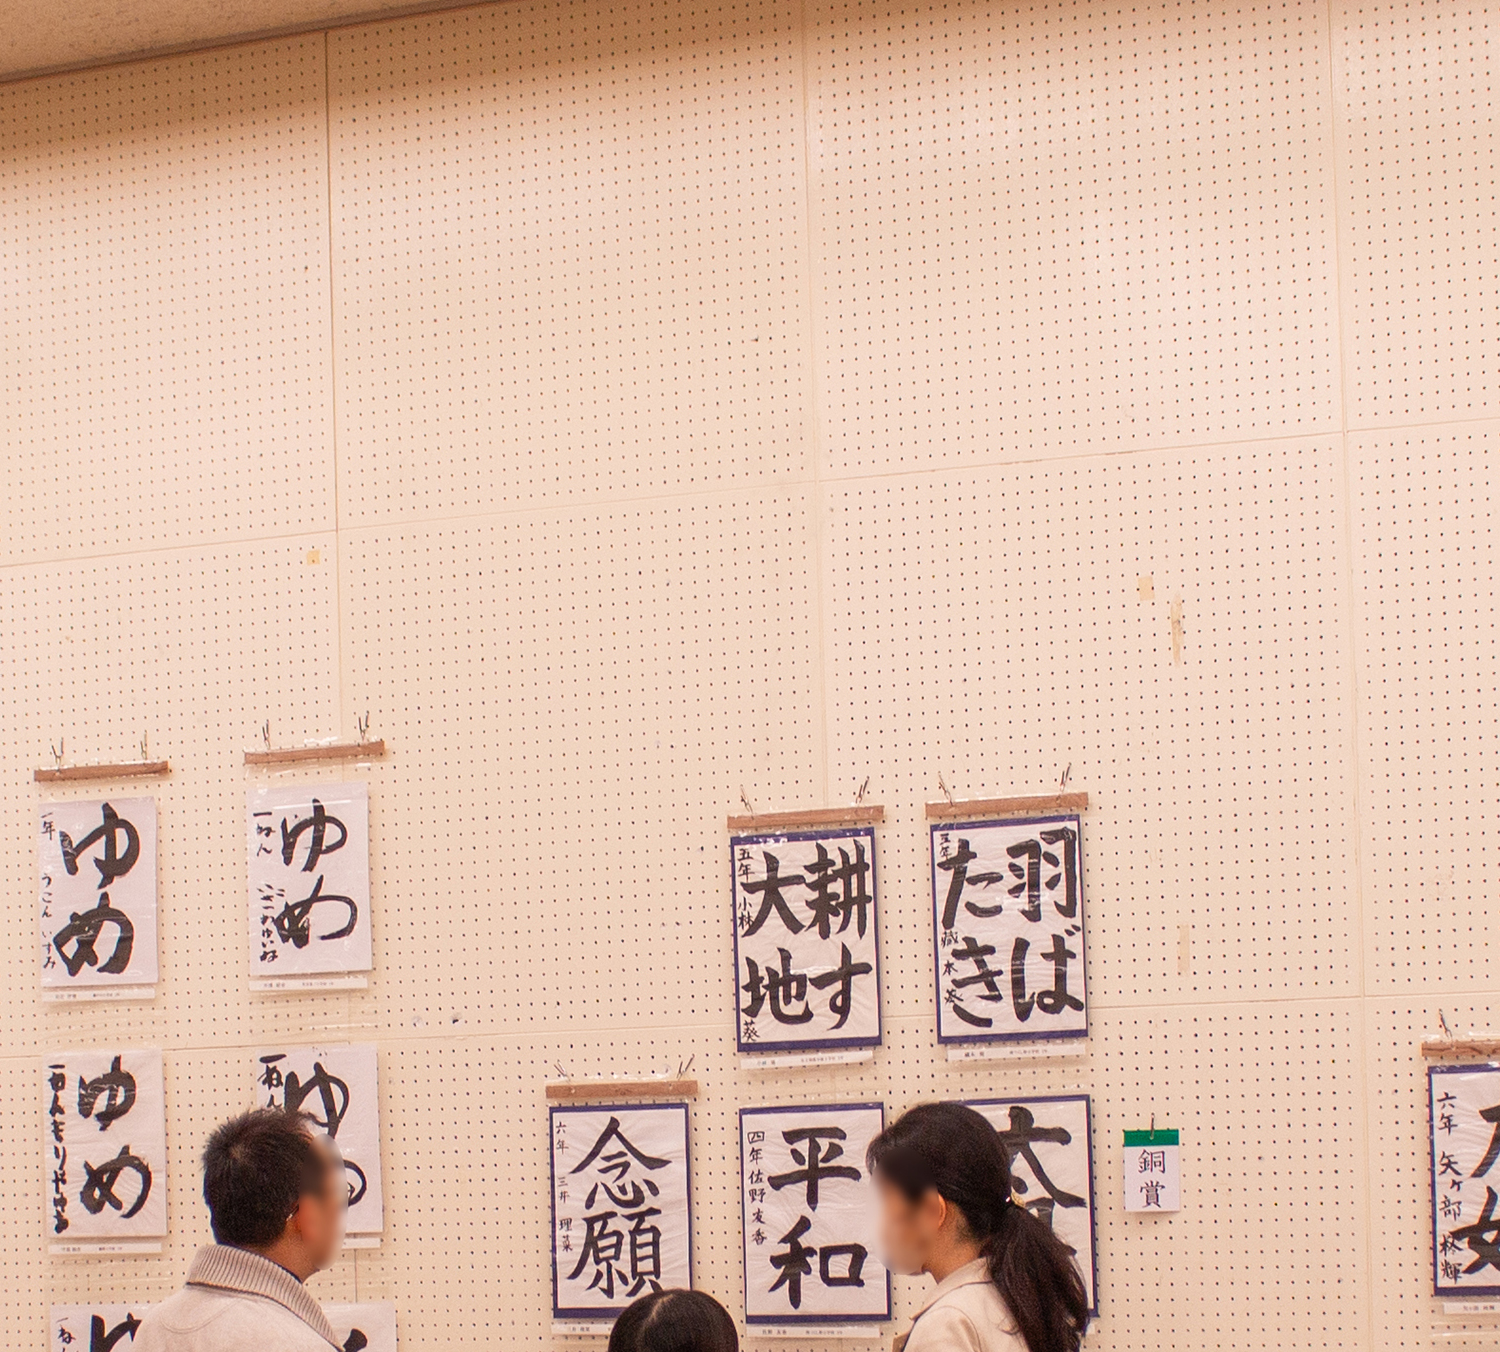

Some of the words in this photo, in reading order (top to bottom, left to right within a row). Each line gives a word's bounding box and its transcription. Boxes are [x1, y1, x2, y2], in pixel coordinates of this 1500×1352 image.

[52, 802, 140, 977] ゆめ
[275, 798, 358, 949] ゆめ
[738, 848, 755, 883] 五年
[78, 1055, 152, 1219] ゆめ
[555, 1121, 569, 1155] 六年
[1137, 1149, 1166, 1208] 銅賞
[1437, 1091, 1458, 1136] 六年
[566, 1116, 672, 1300] 念願
[767, 1127, 869, 1310] 平和
